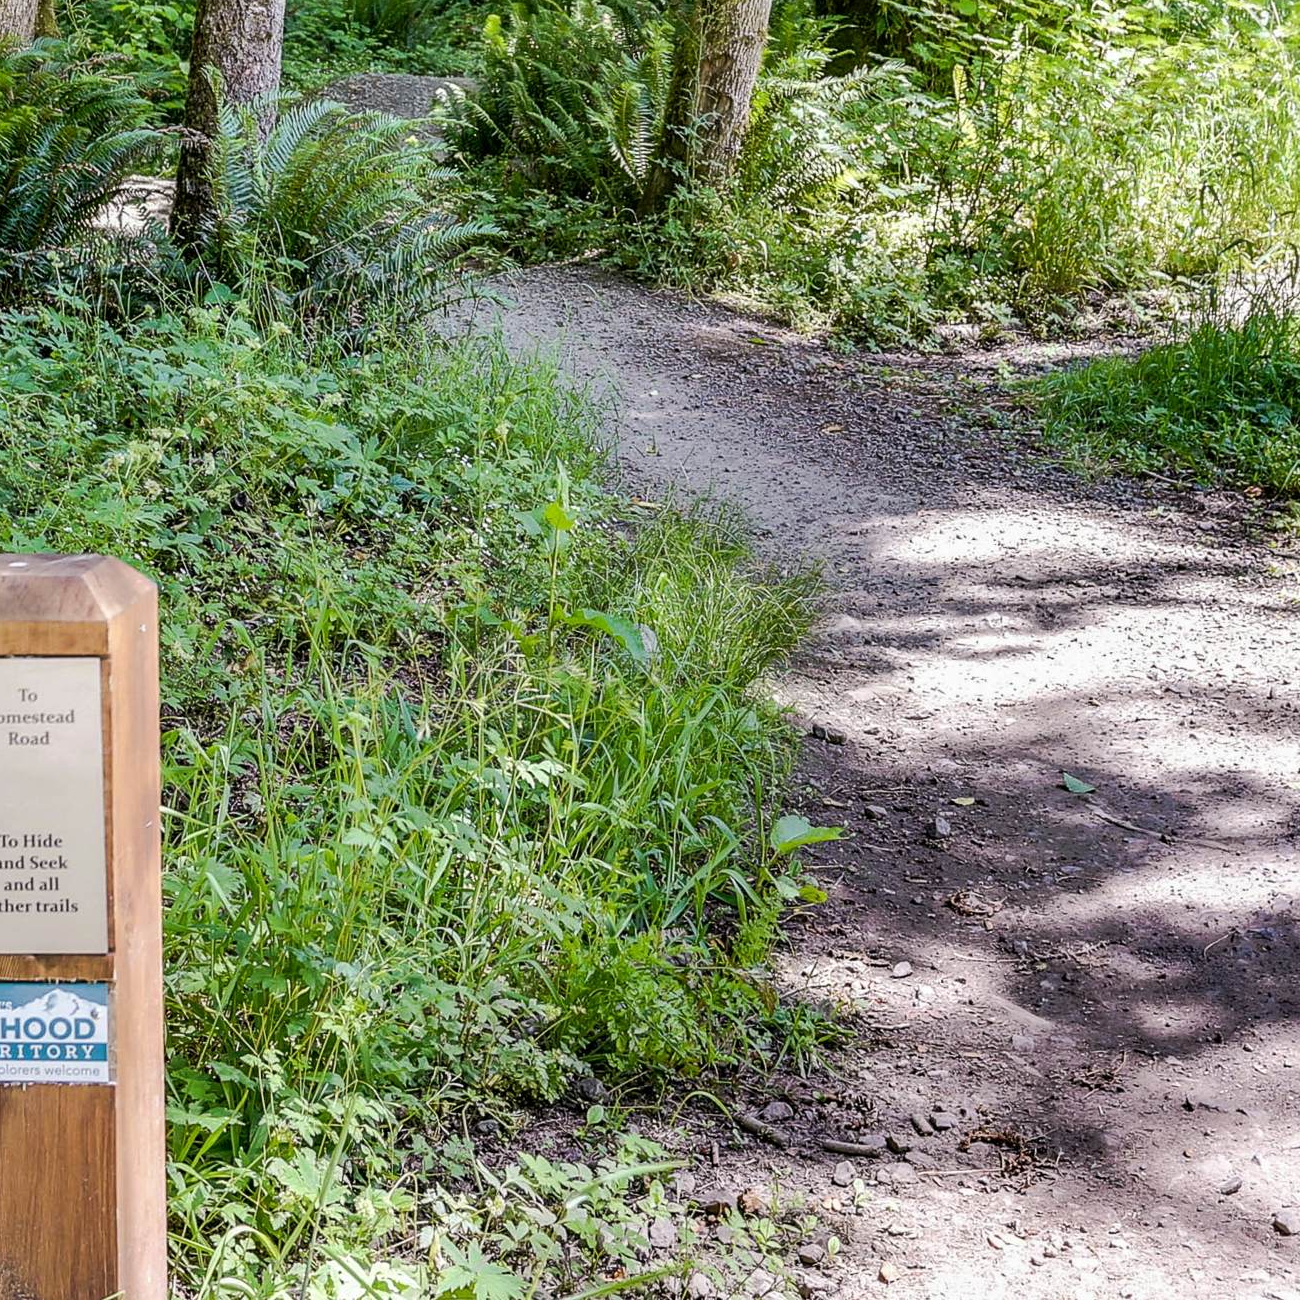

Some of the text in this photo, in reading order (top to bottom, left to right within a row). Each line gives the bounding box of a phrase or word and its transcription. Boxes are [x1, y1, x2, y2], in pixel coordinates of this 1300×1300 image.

[18, 688, 38, 703] To
[8, 731, 50, 746] Road
[23, 834, 63, 848] Hide
[30, 856, 68, 869] Seek
[3, 877, 59, 891] and all
[36, 899, 79, 913] trails
[0, 1017, 96, 1040] HOOD
[44, 1064, 100, 1077] welcome
